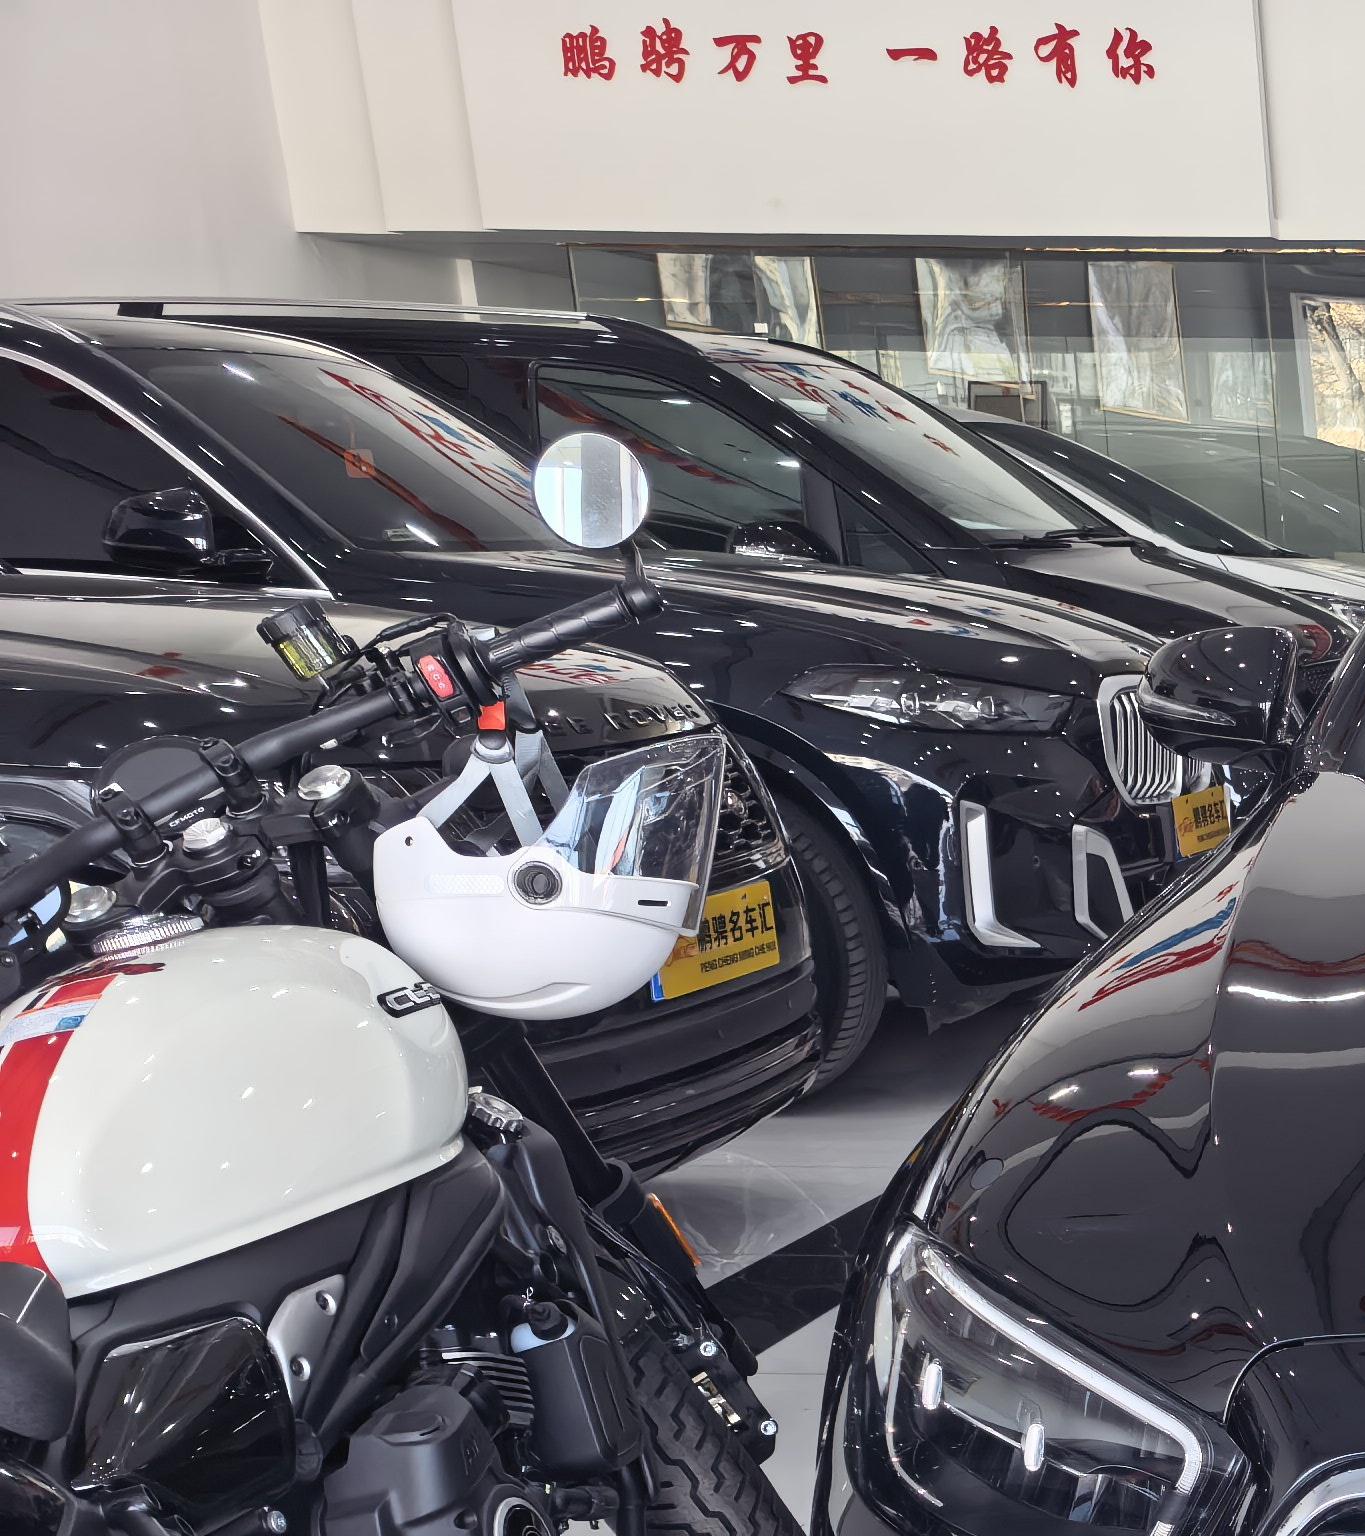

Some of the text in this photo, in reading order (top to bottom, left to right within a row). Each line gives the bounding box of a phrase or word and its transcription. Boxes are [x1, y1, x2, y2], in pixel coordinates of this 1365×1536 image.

[561, 18, 1157, 89] 鹏骋万里 一路有你
